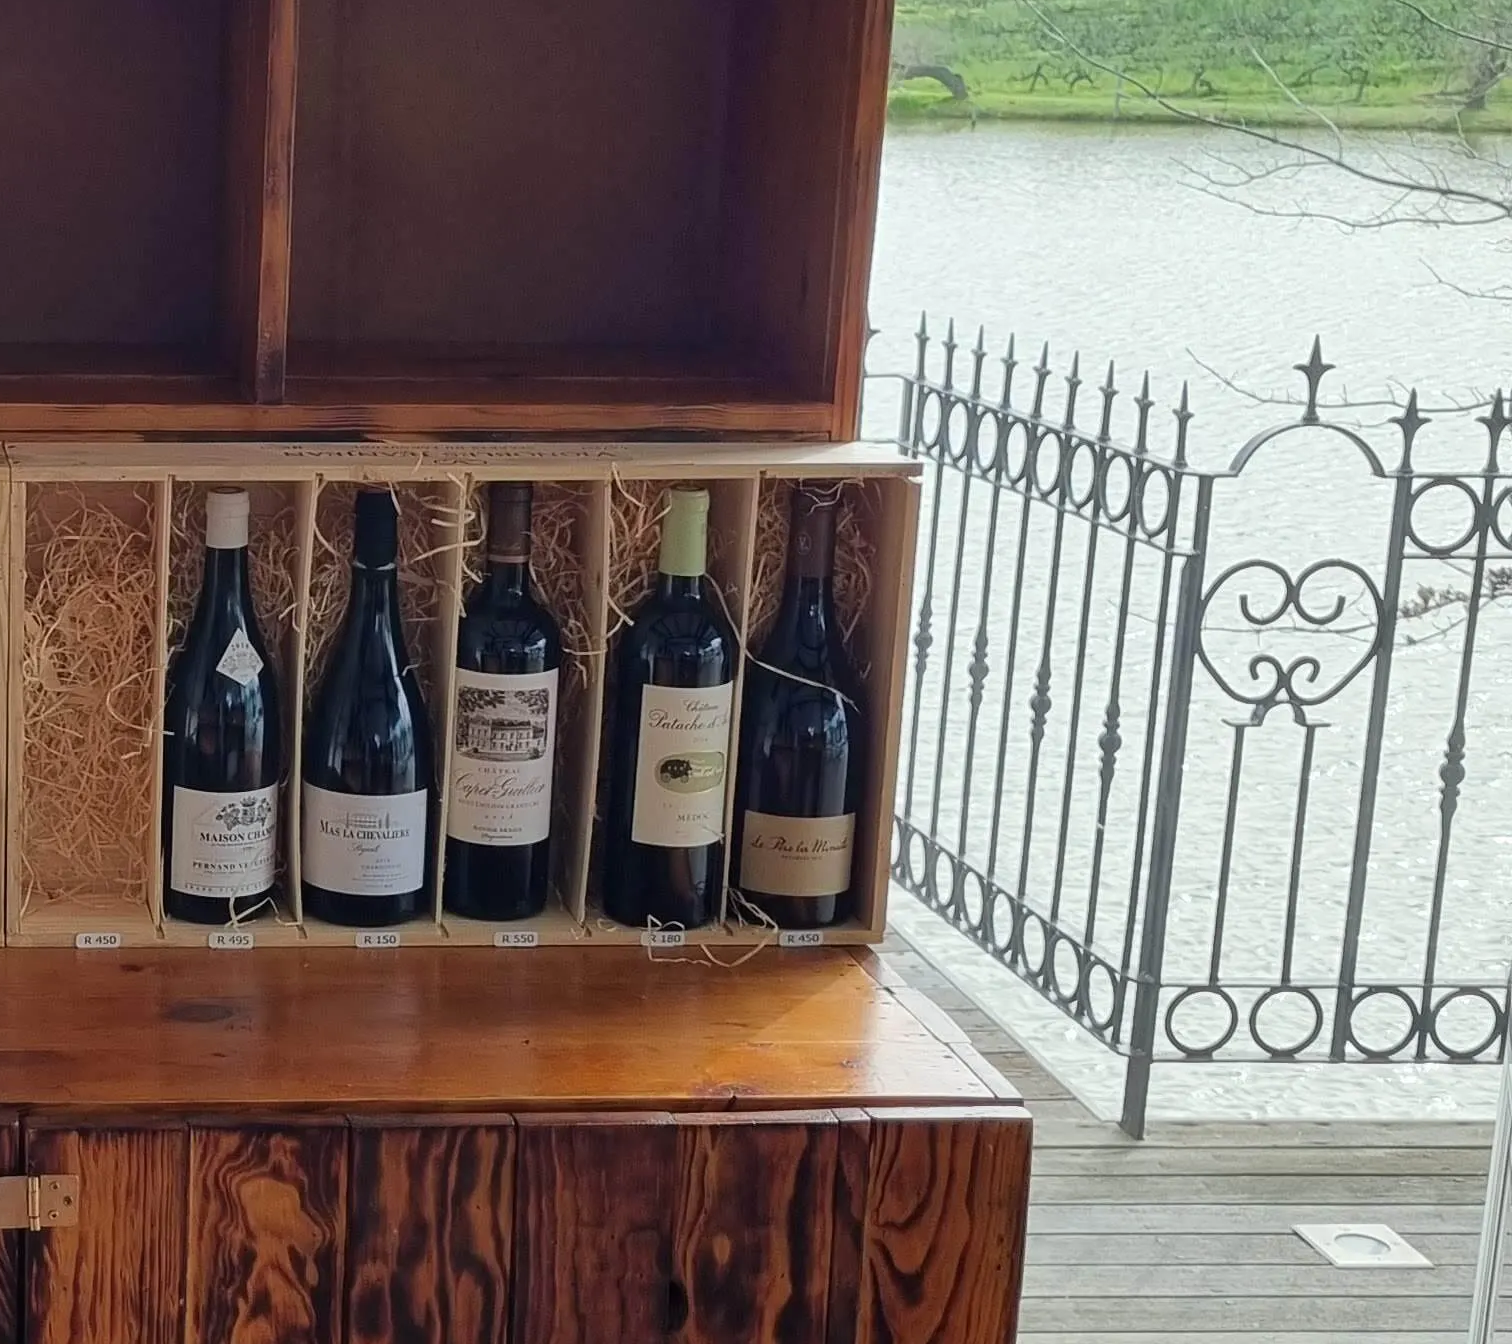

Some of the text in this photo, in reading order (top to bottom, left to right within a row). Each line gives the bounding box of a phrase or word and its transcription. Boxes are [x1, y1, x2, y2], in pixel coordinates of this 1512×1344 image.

[648, 708, 705, 731] Patache
[319, 819, 340, 837] MAS
[343, 828, 355, 839] LA
[199, 832, 246, 843] MAISON
[84, 935, 117, 945] R 450
[217, 935, 250, 945] R 495
[364, 935, 397, 944] R 150
[502, 934, 535, 944] R 550
[661, 934, 681, 943] 180
[787, 933, 820, 943] R 450
